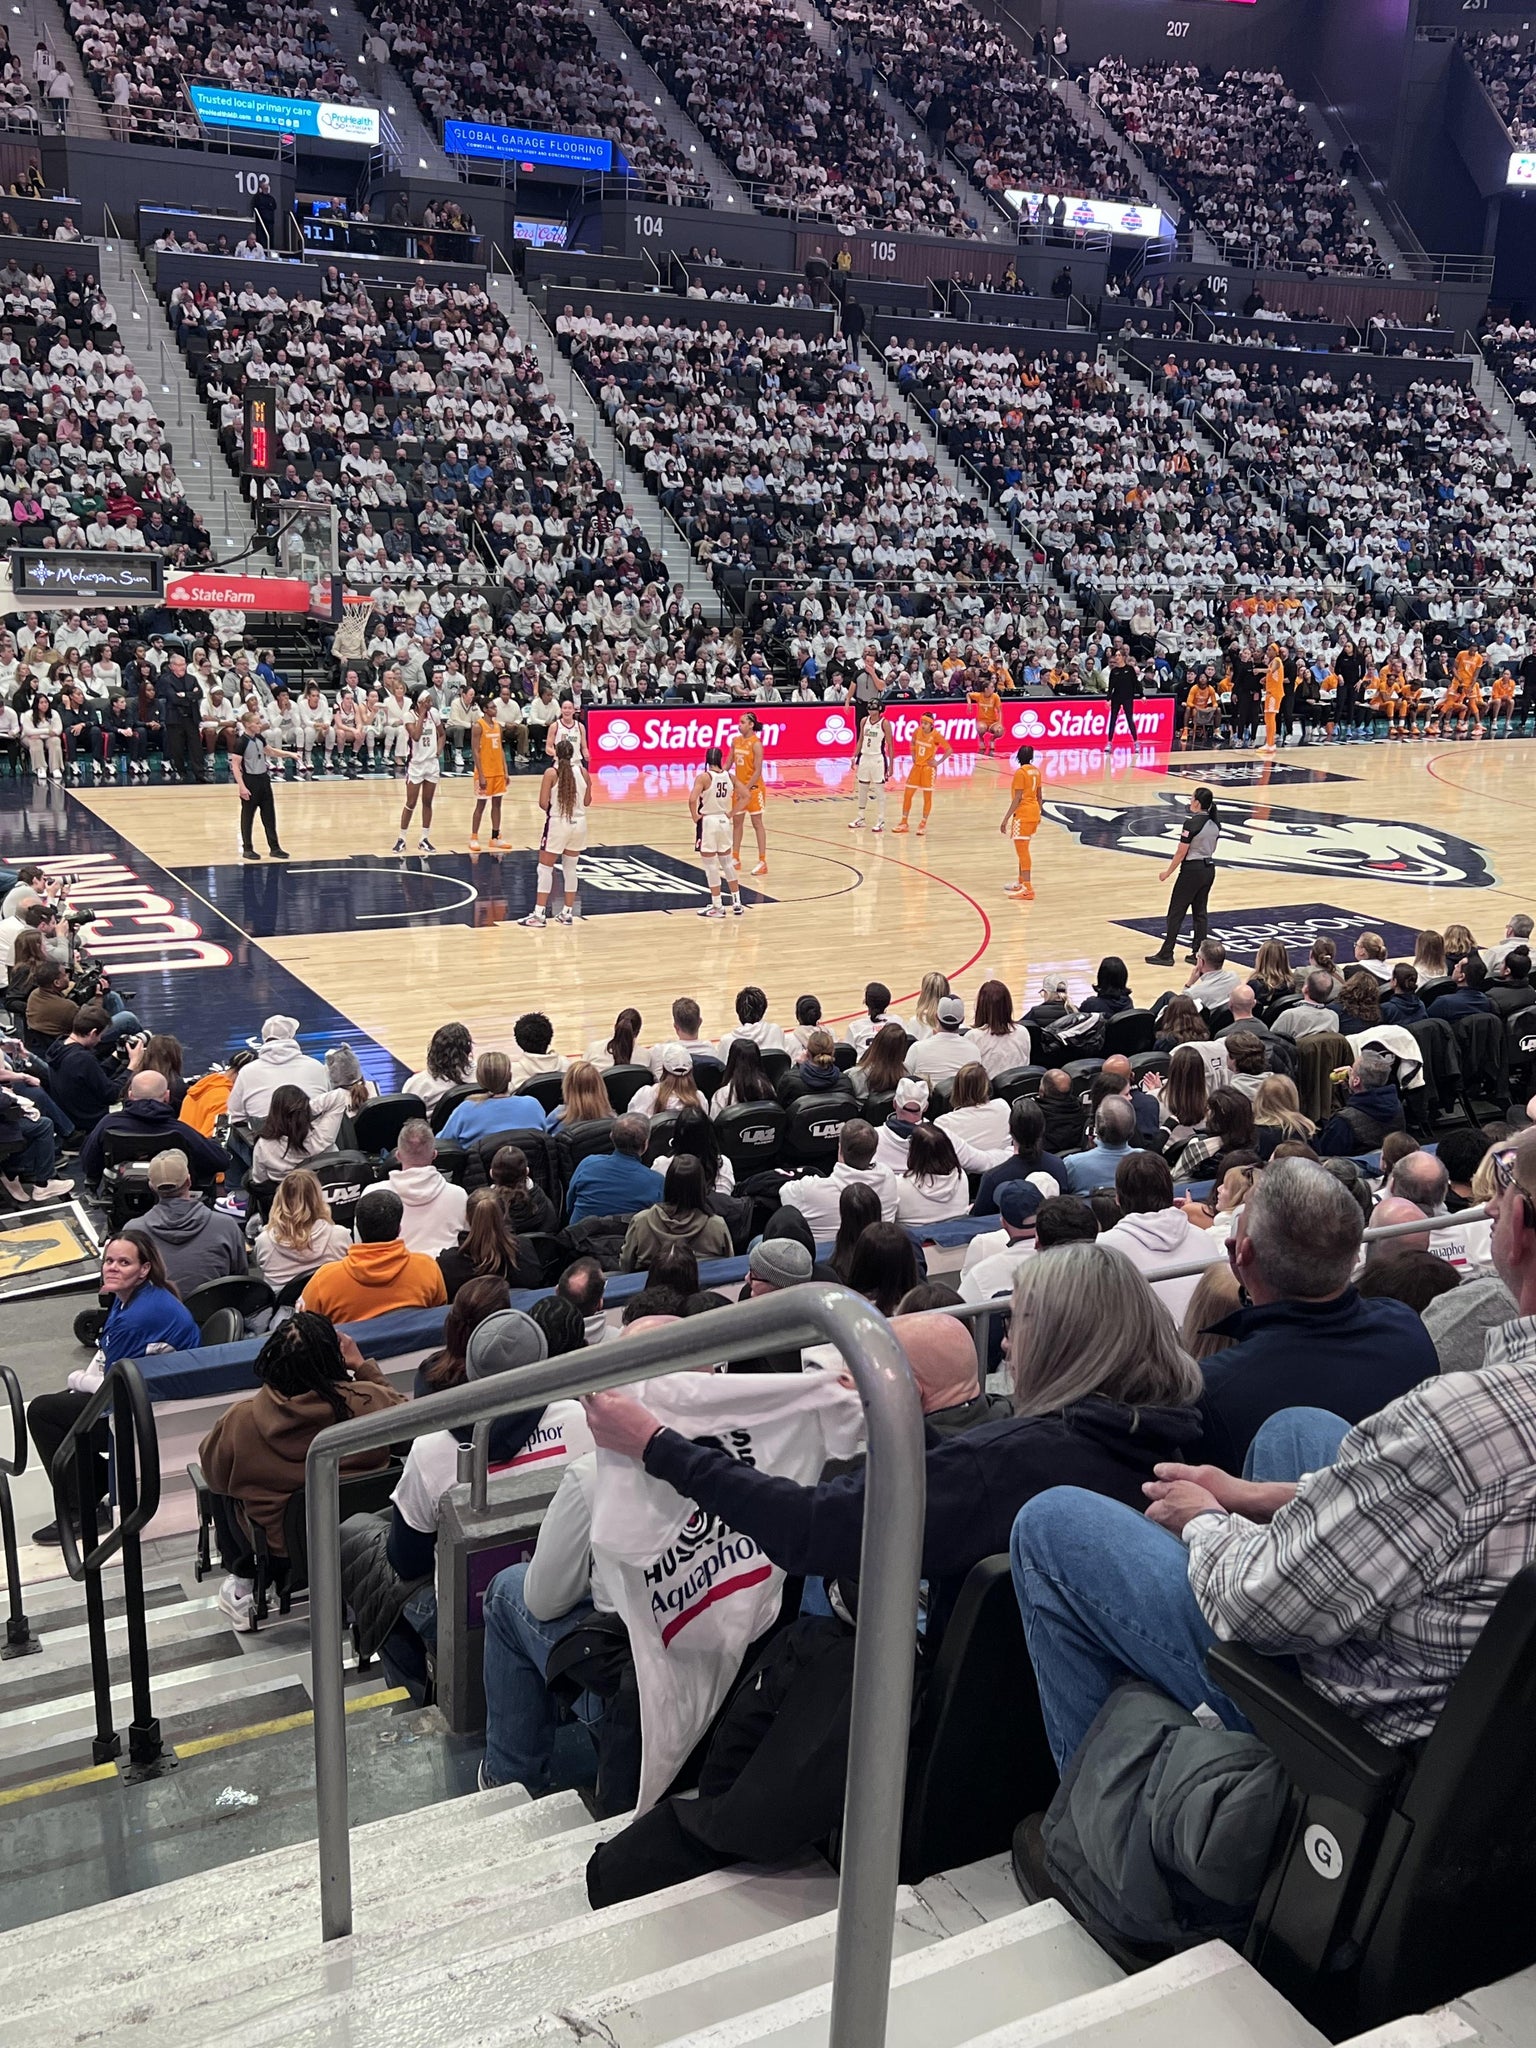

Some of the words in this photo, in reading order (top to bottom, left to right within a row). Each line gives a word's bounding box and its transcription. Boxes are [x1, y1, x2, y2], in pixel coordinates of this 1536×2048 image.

[1166, 21, 1190, 37] 207
[197, 93, 233, 106] Trusted
[234, 97, 255, 109] local
[256, 101, 292, 116] primary
[292, 107, 312, 116] care
[331, 112, 374, 127] ProHealth
[454, 128, 497, 143] GLOBAL
[502, 134, 545, 149] GARAGE
[550, 140, 604, 156] FLOORING
[634, 214, 663, 237] 104
[871, 241, 896, 261] 105
[56, 568, 118, 585] Mohegan
[119, 570, 150, 586] Sun
[716, 782, 728, 798] 35
[2, 853, 234, 975] UCONN
[742, 1127, 775, 1143] LAZ
[321, 1184, 361, 1204] LAZ
[1314, 1838, 1332, 1868] G
